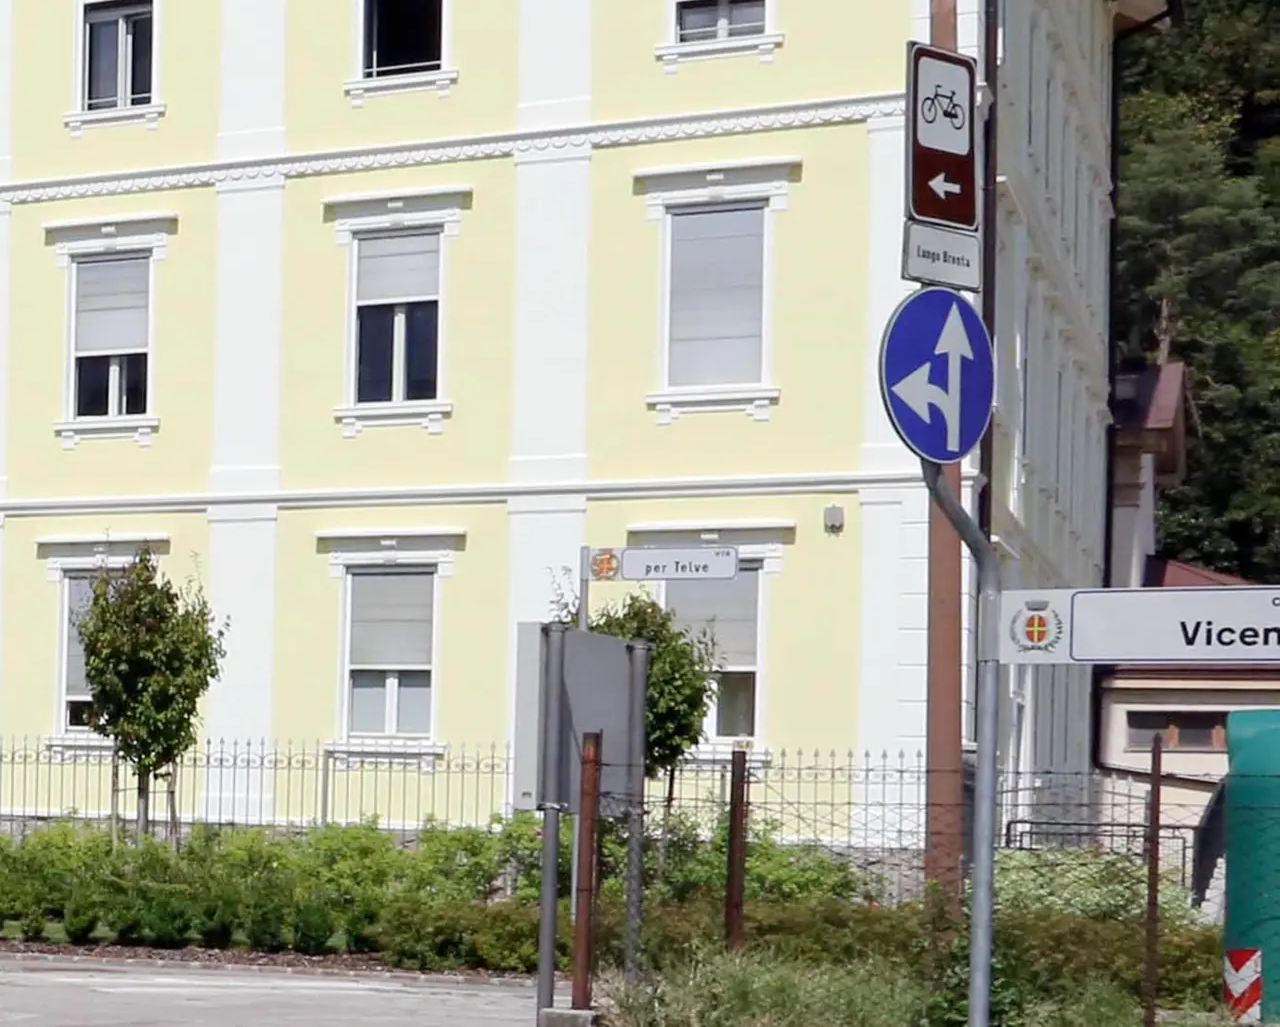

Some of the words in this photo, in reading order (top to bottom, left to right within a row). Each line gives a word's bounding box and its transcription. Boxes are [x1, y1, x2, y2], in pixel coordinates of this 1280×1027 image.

[645, 563, 668, 576] per
[674, 560, 710, 573] Telve
[1179, 620, 1280, 647] Vicen
